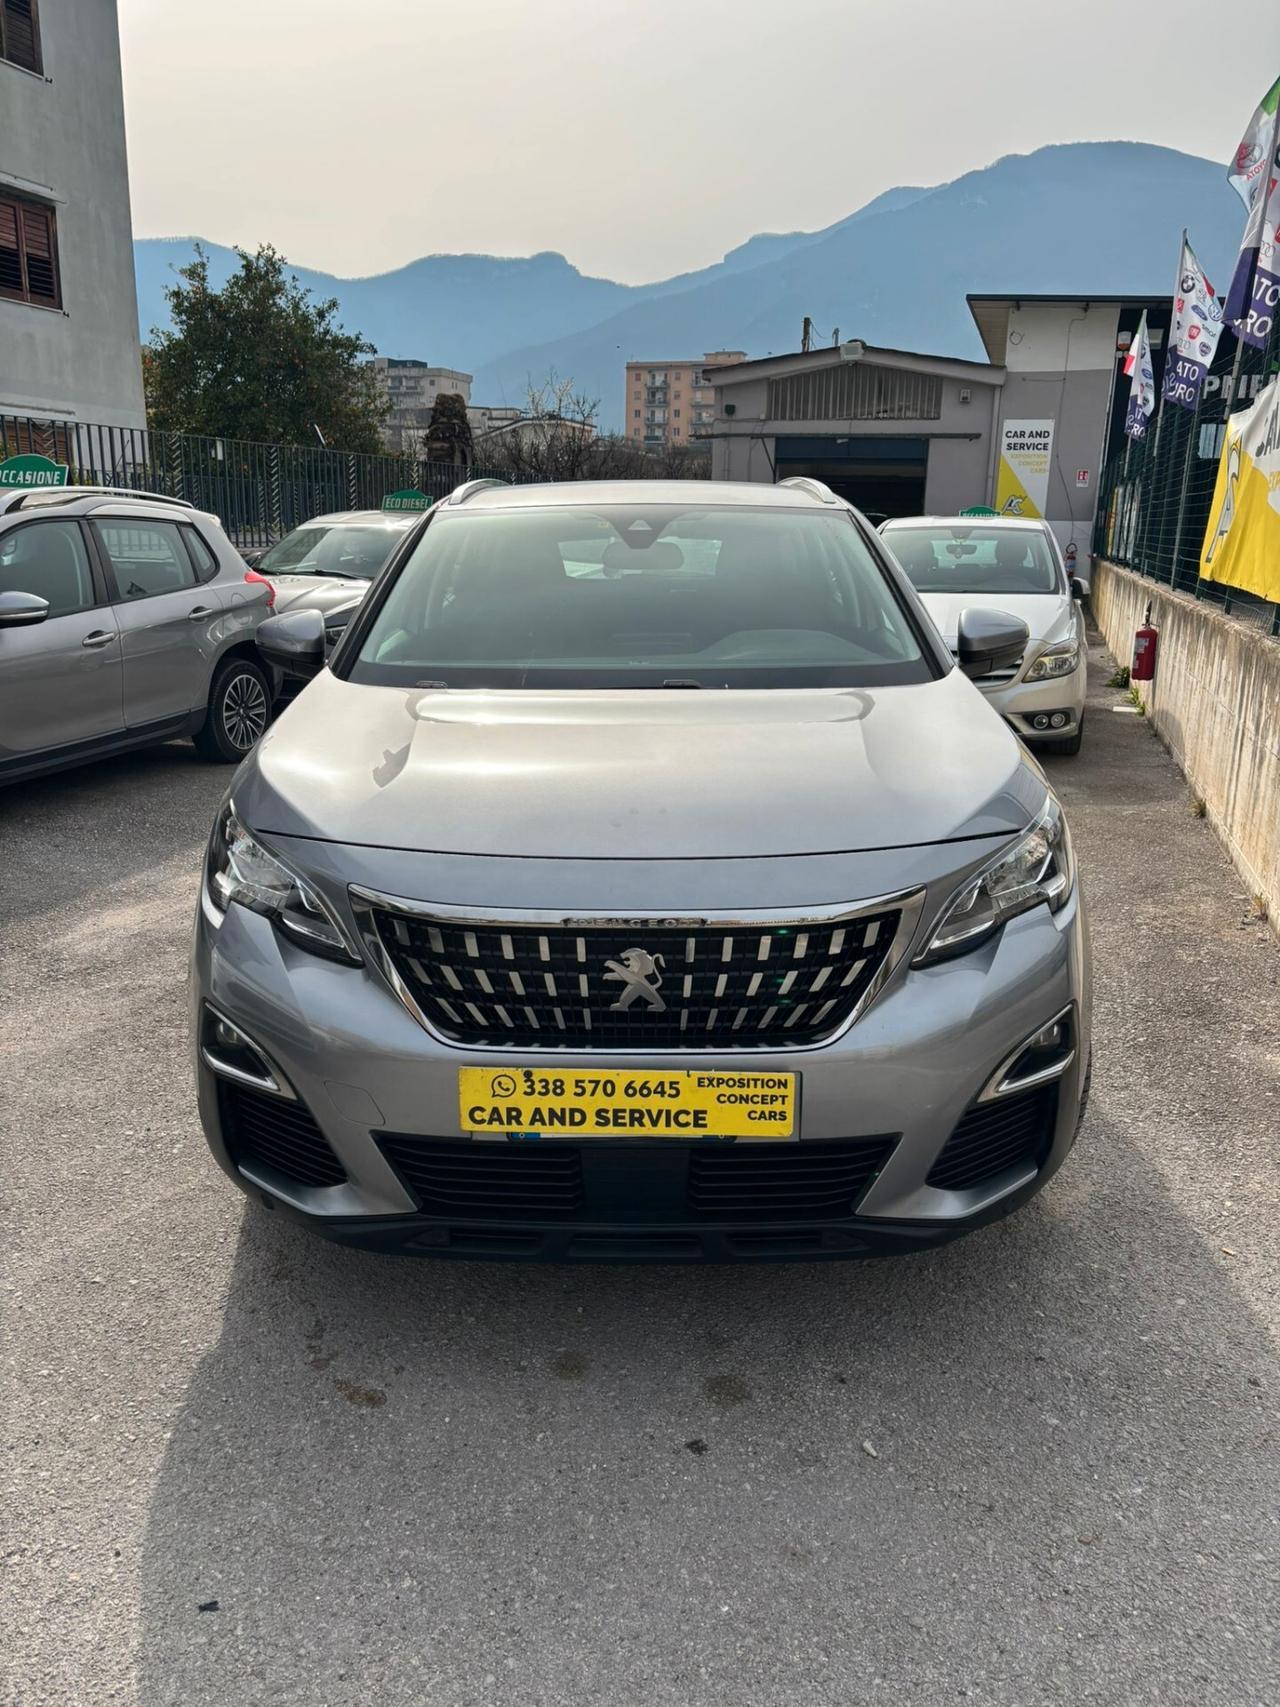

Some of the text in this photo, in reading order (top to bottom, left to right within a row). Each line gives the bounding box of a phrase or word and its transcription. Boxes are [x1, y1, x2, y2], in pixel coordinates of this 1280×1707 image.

[1005, 430, 1050, 439] CAR AND
[1006, 442, 1049, 451] SERVICE
[0, 470, 60, 485] CCASIONE
[385, 498, 430, 509] ECO DIESEL
[523, 1078, 680, 1098] 338 570 6645
[697, 1077, 788, 1090] EXPOSITION
[716, 1093, 788, 1105] CONCEPT
[468, 1106, 708, 1128] CAR AND SERVICE
[747, 1109, 787, 1121] CARS
